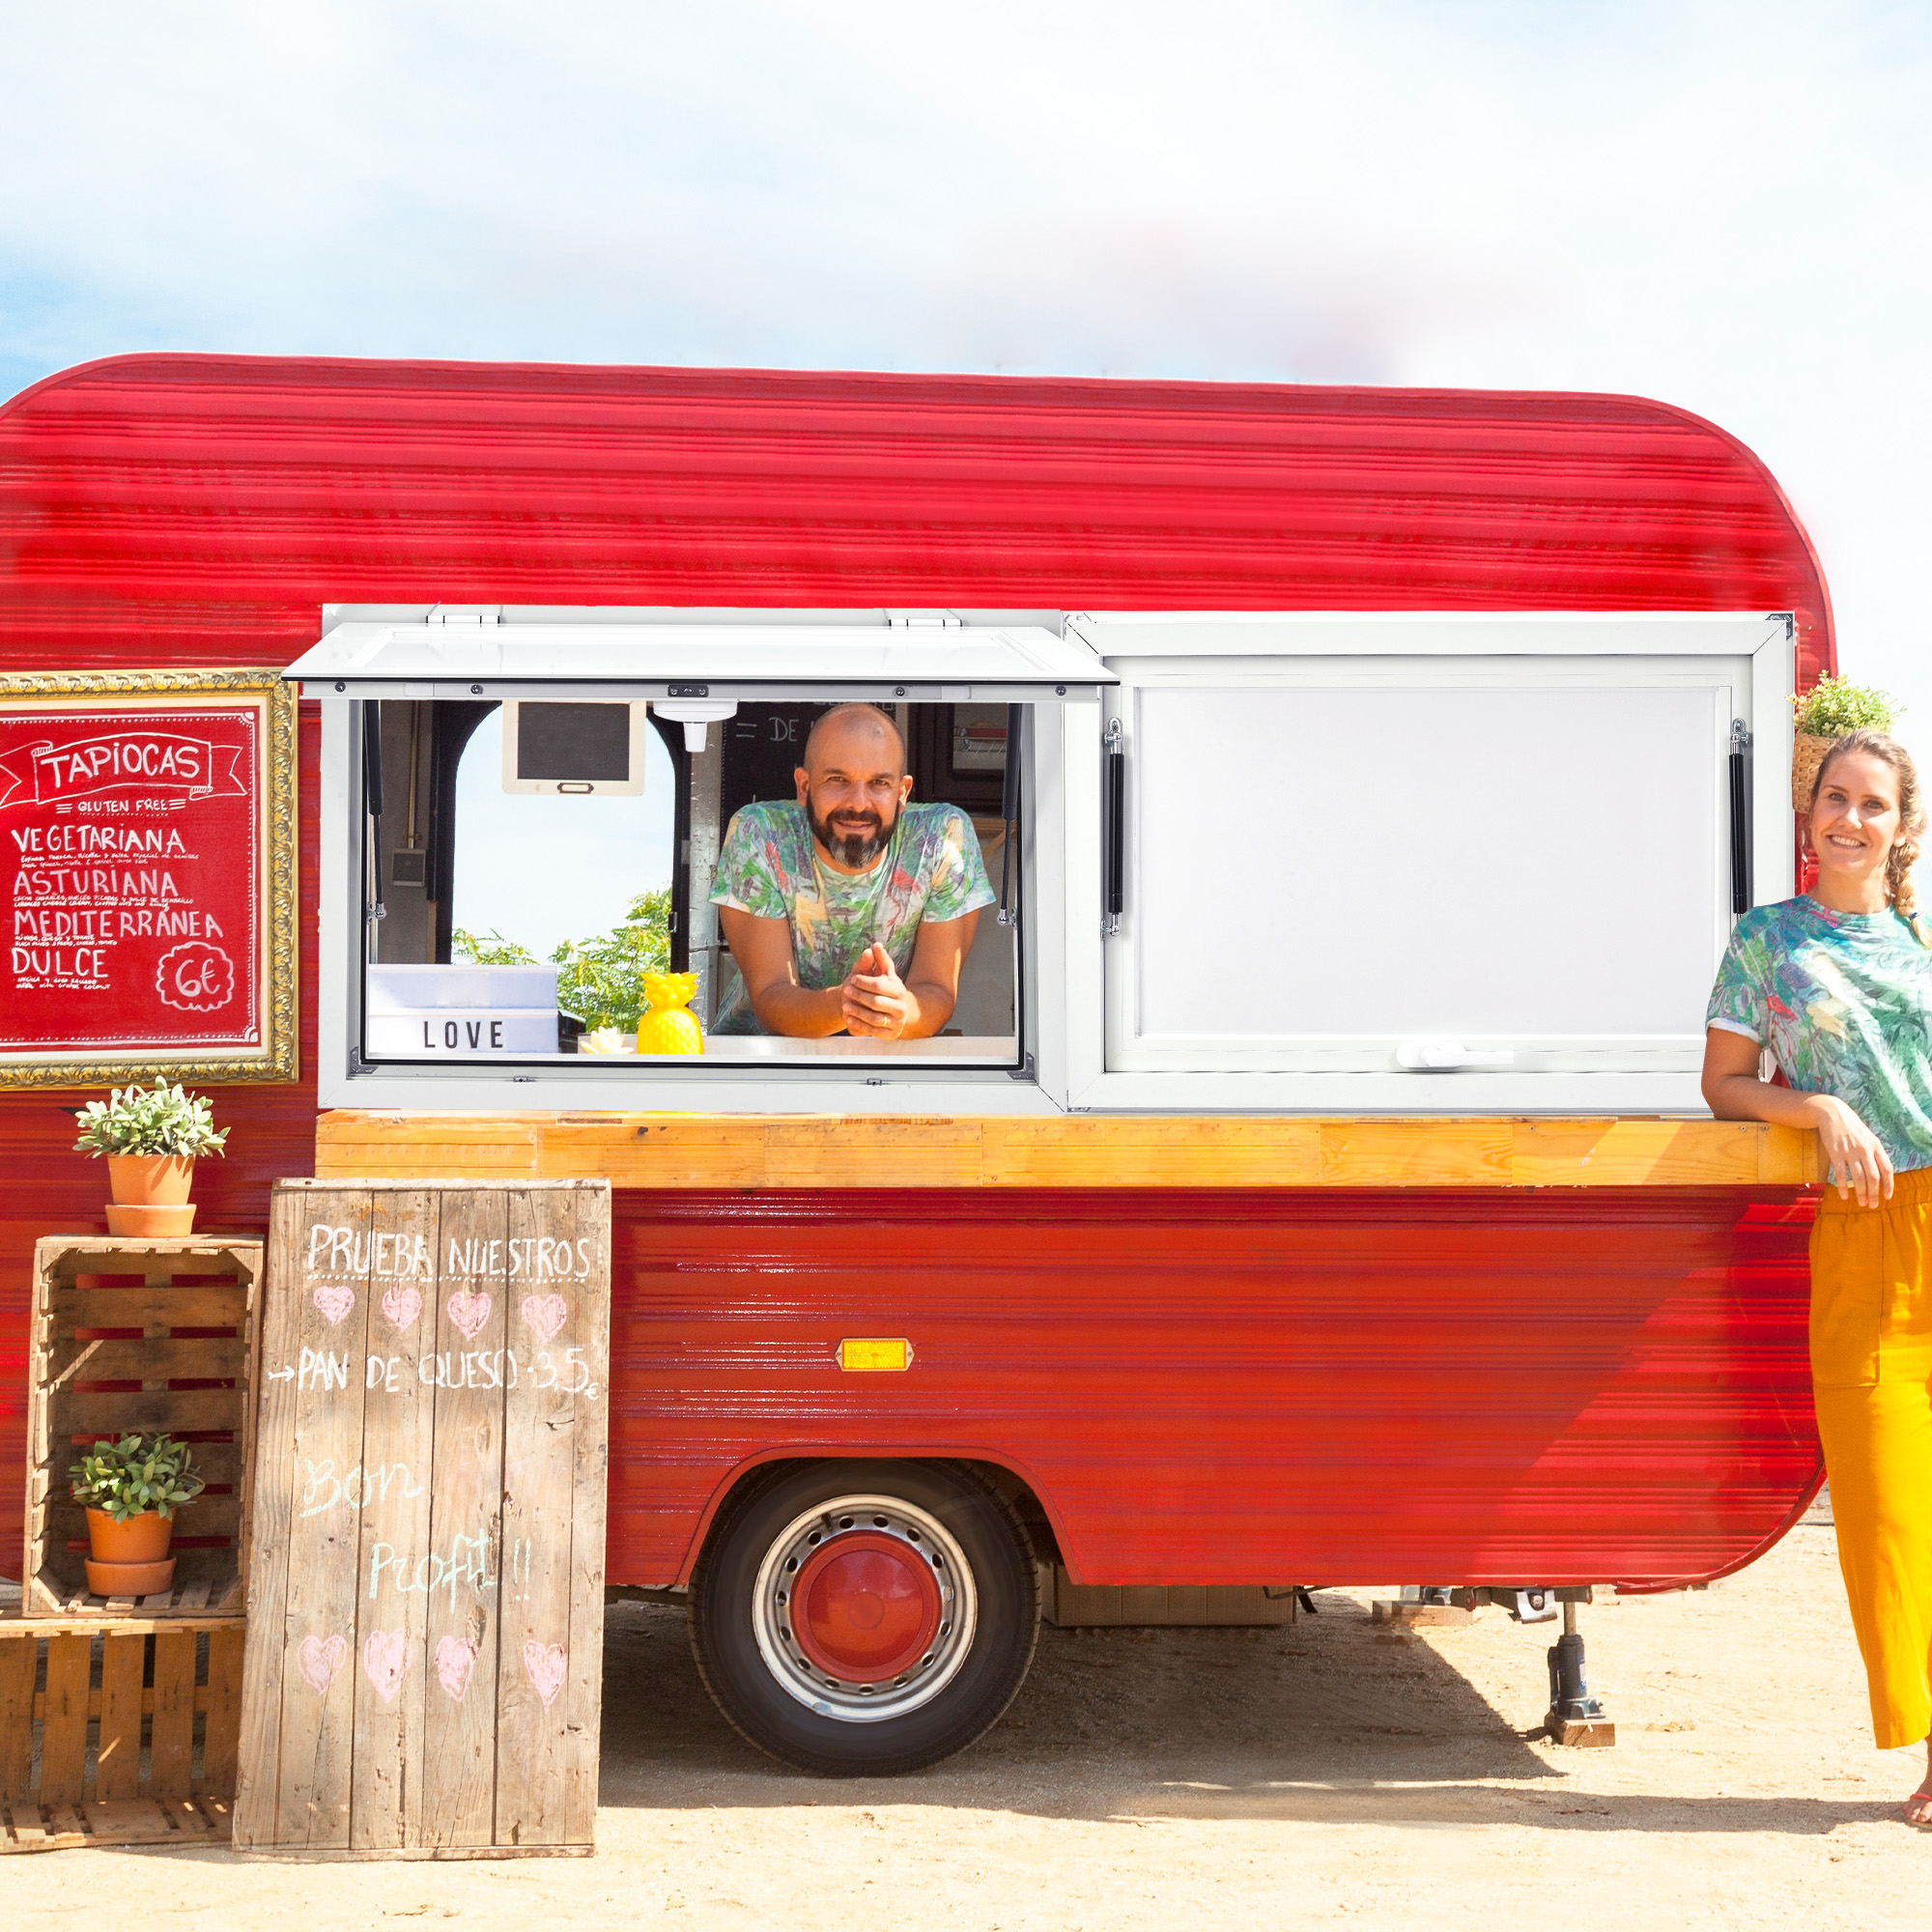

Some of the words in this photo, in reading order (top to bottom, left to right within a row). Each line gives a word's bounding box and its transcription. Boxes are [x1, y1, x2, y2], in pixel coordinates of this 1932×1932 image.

[78, 801, 129, 812] GLUTEN
[136, 799, 168, 810] FREE
[12, 947, 108, 978] DULCE
[175, 957, 220, 997] 6€
[424, 1021, 503, 1049] LOVE
[307, 1223, 434, 1277] PRUEBA
[298, 1347, 349, 1391] PAN
[366, 1354, 401, 1392] DE
[418, 1350, 518, 1389] QUESO
[298, 1459, 425, 1519] Bon
